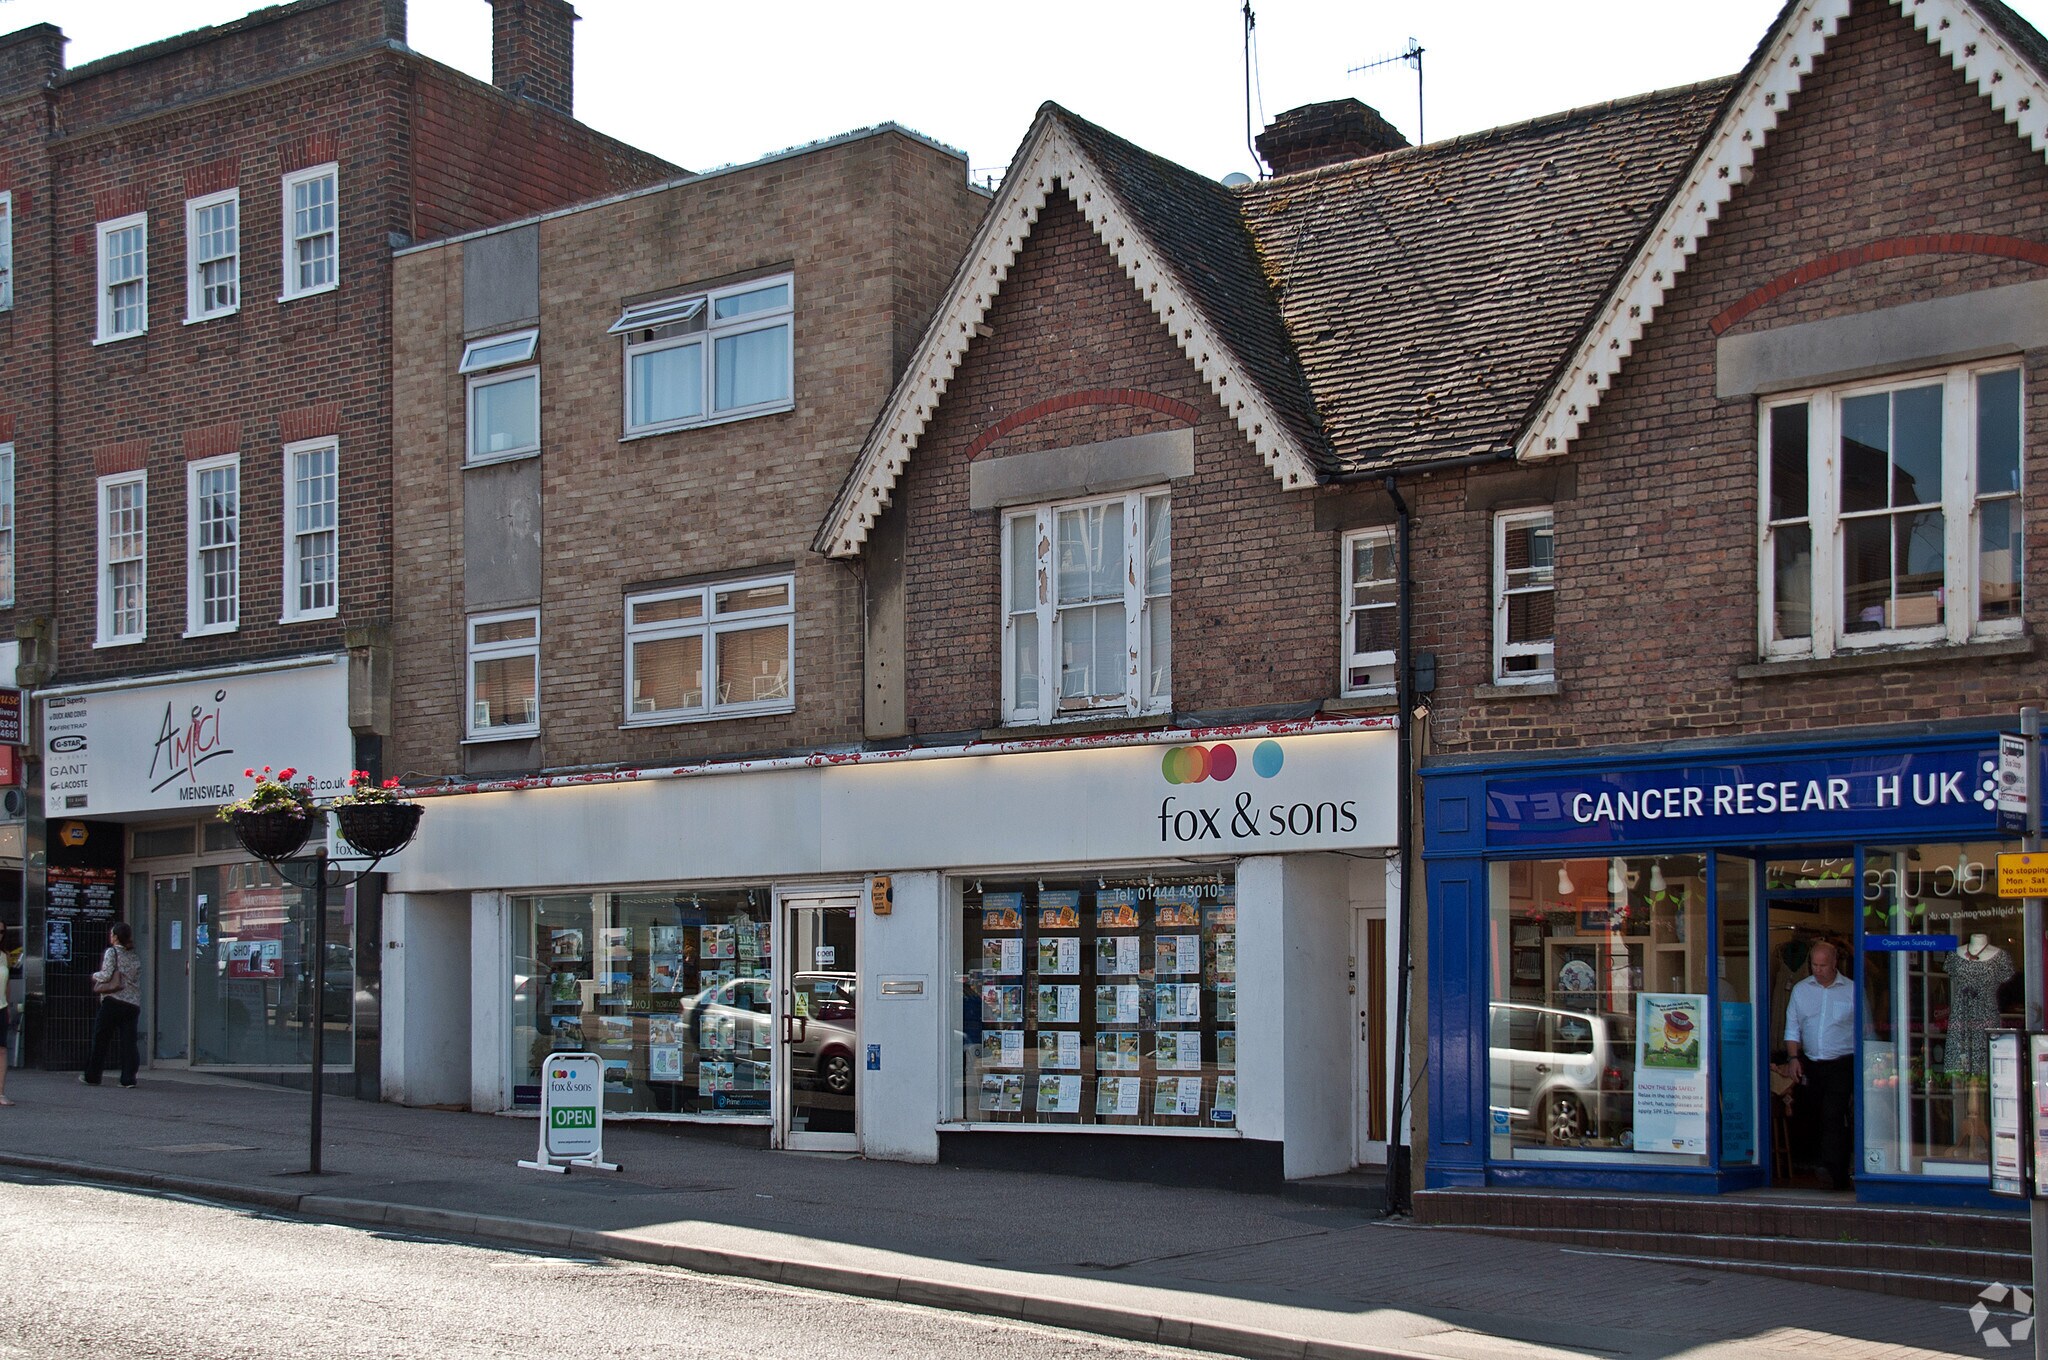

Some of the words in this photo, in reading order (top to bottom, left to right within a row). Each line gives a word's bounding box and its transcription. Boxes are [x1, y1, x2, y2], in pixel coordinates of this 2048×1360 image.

[50, 764, 88, 776] GANT
[61, 780, 88, 789] LACOSTE
[179, 784, 235, 800] MENSWEAR
[1572, 788, 1703, 823] CANCER
[1911, 770, 1964, 805] UK
[1157, 796, 1221, 842] fox
[1231, 791, 1261, 838] &
[1269, 800, 1358, 836] sons
[335, 842, 353, 855] fox
[2031, 876, 2045, 884] Sat
[1113, 886, 1134, 901] Tel:
[1138, 885, 1175, 900] 01444
[1179, 884, 1225, 899] 450105
[2000, 887, 2026, 895] except
[1882, 938, 1900, 947] Open
[1911, 938, 1936, 948] Sundays
[552, 1081, 565, 1092] fox
[566, 1081, 574, 1092] &
[574, 1083, 592, 1092] sons
[556, 1109, 592, 1125] OPEN
